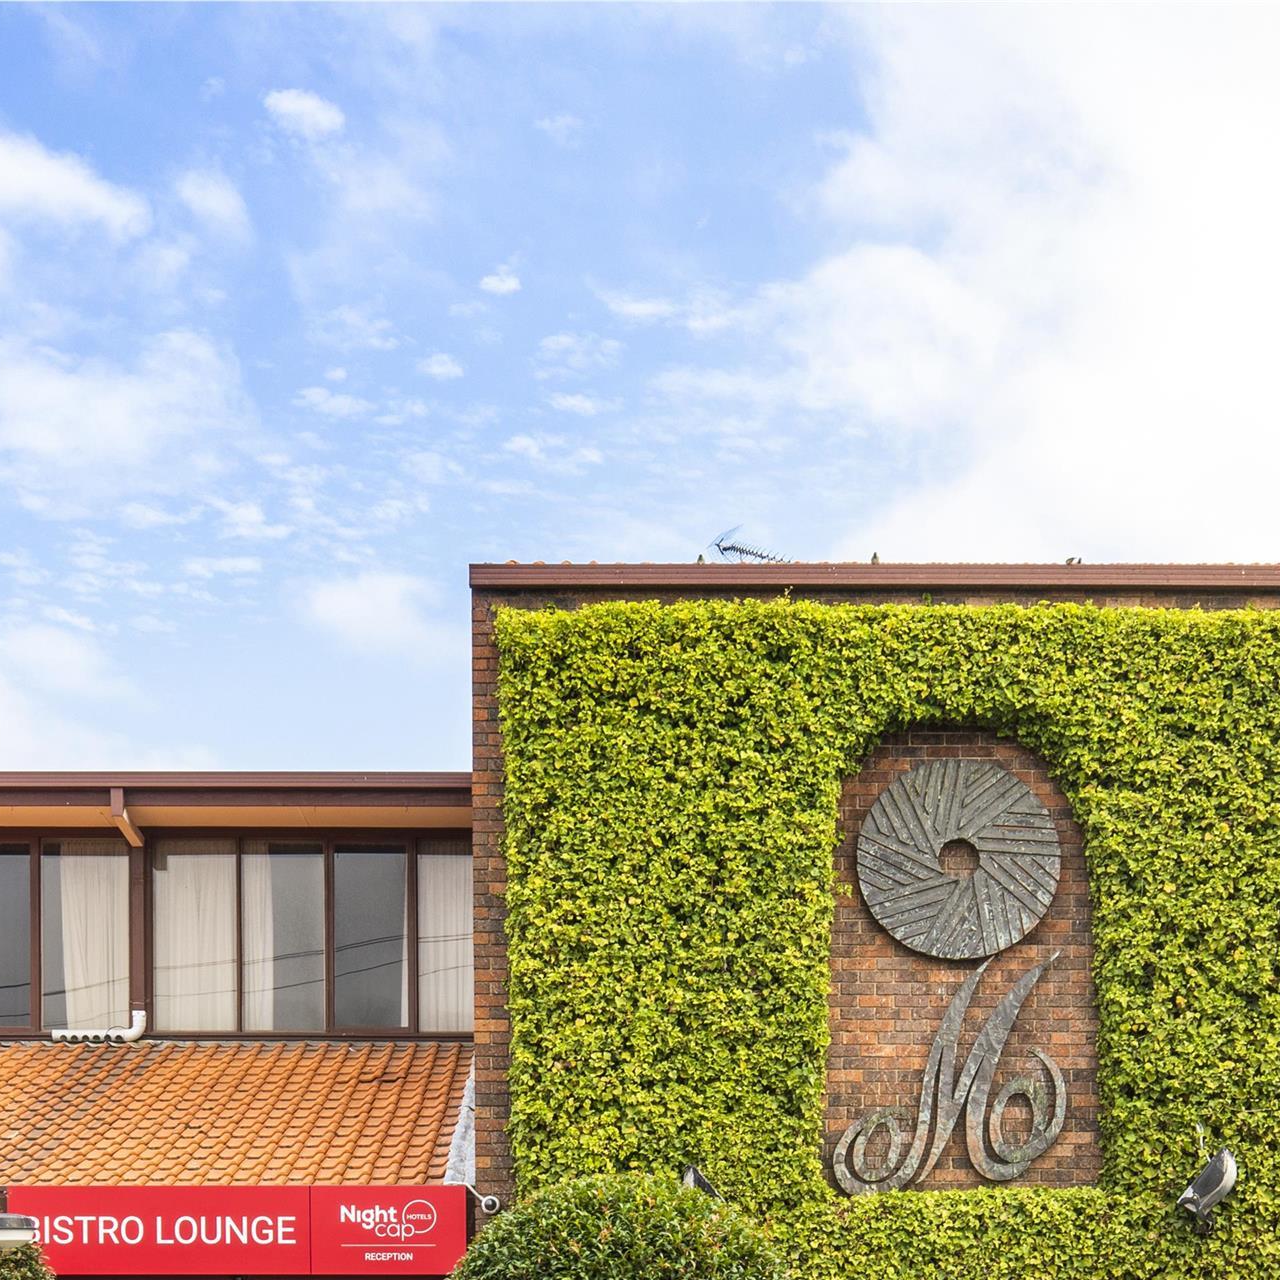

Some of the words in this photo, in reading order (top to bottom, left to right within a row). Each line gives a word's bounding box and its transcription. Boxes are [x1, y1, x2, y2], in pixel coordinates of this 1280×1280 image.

[340, 1204, 398, 1230] Night
[155, 1215, 297, 1245] LOUNGE
[375, 1223, 415, 1241] cap
[364, 1252, 413, 1261] RECEPTION
